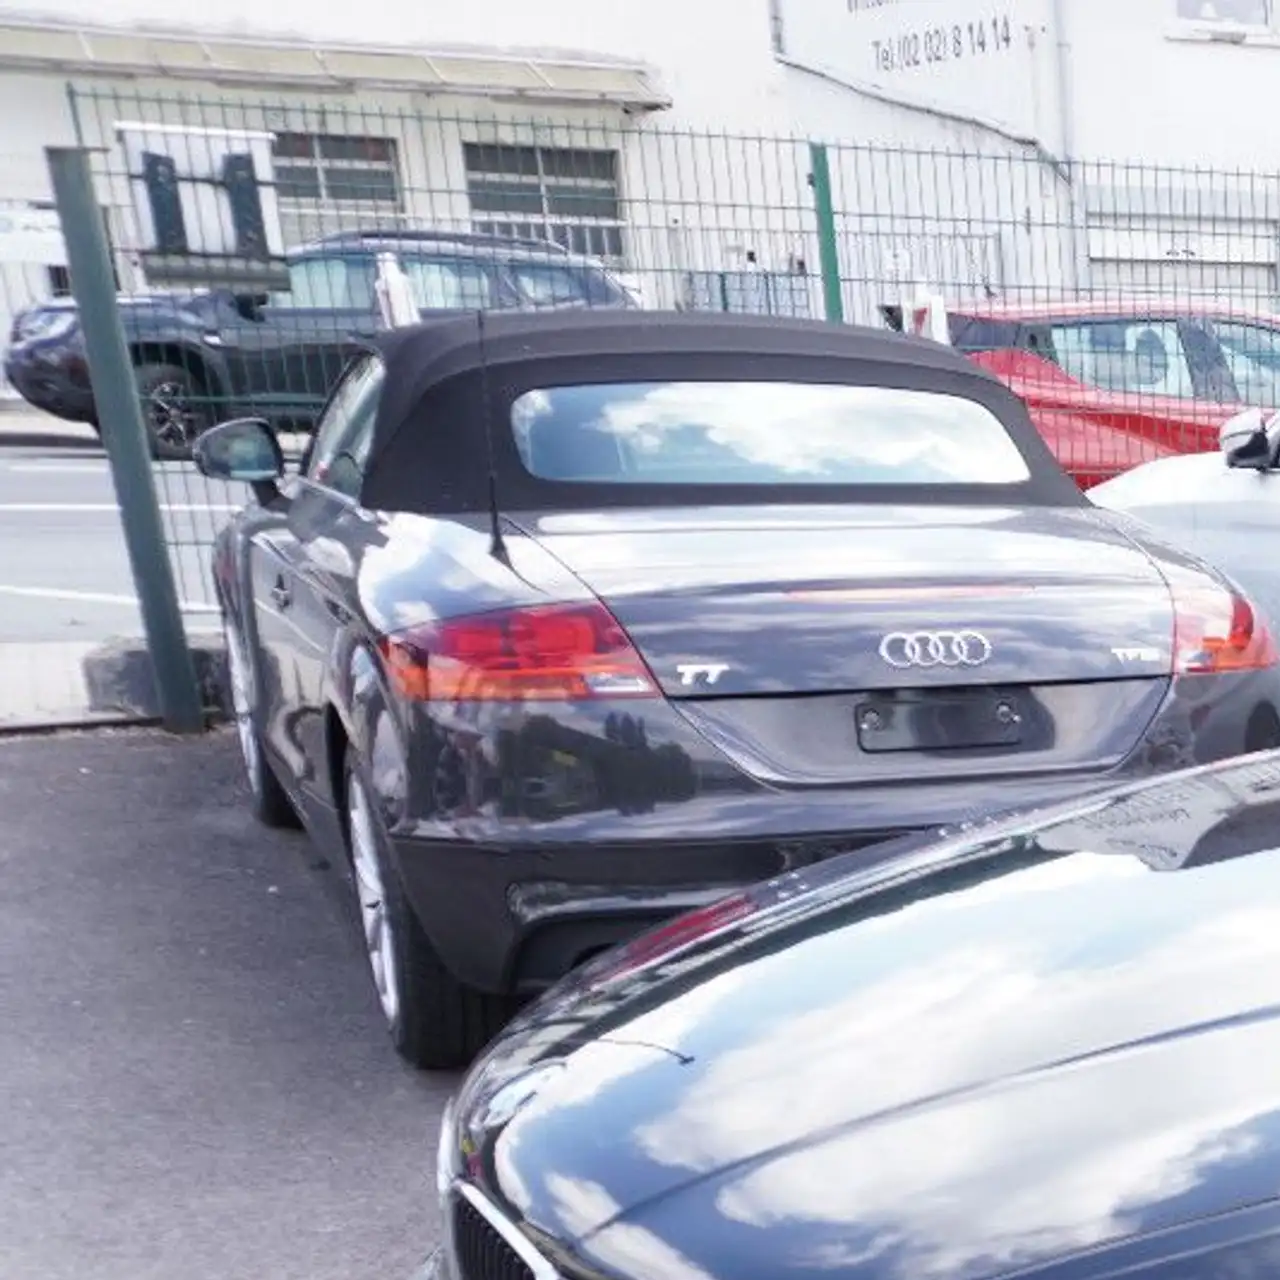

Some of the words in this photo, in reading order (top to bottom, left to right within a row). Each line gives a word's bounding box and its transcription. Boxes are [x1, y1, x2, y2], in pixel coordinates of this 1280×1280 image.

[952, 24, 963, 58] 8
[967, 20, 987, 55] 14
[991, 14, 1012, 50] 14
[676, 664, 731, 686] TT
